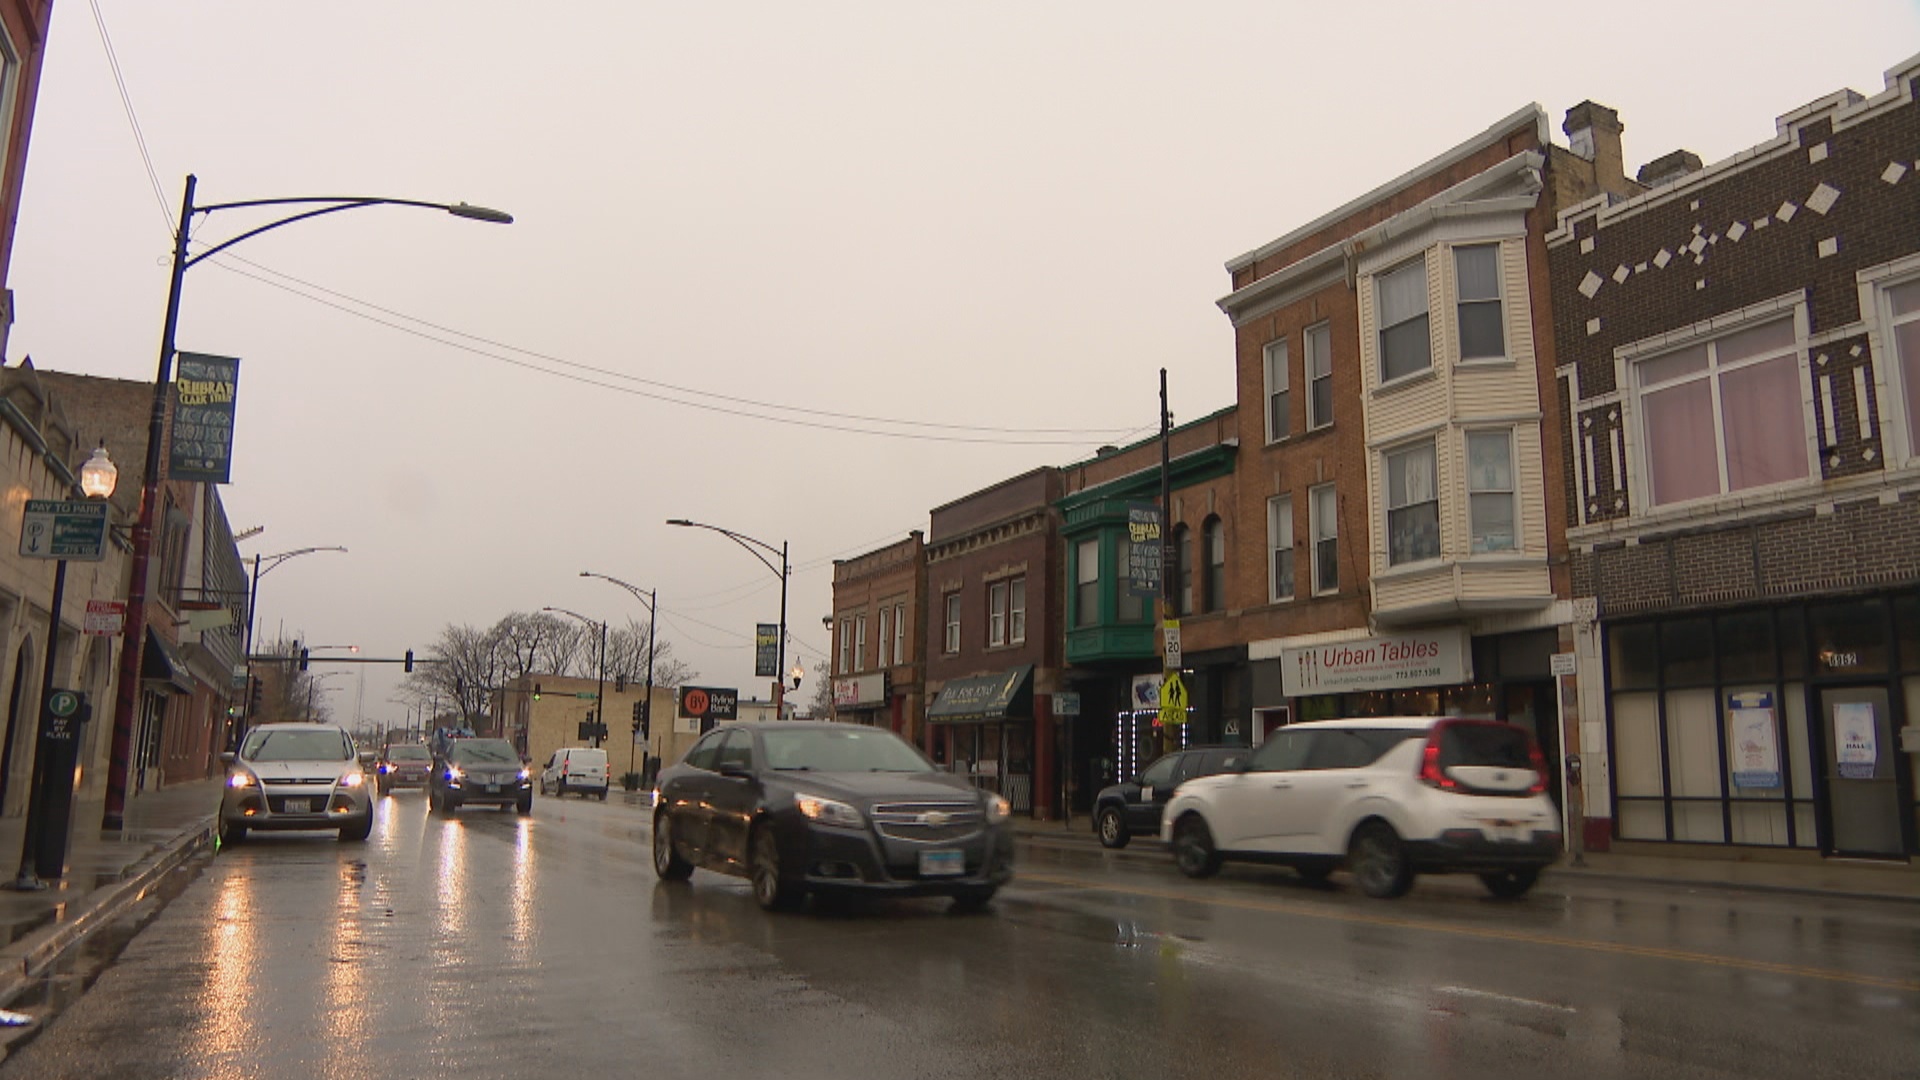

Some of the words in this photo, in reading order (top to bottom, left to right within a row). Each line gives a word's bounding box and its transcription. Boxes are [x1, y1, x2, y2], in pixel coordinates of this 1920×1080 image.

[179, 394, 207, 405] CLARK
[31, 502, 51, 511] PAY
[56, 503, 71, 513] TO
[73, 504, 100, 514] PARK
[1168, 641, 1180, 653] 20
[1324, 647, 1376, 668] Urban
[1379, 639, 1439, 662] Tables
[58, 695, 71, 712] P
[690, 695, 705, 709] BY
[711, 693, 735, 705] Byline
[710, 704, 731, 713] Bank
[1163, 711, 1184, 721] AHEAD
[46, 731, 71, 739] PLATE
